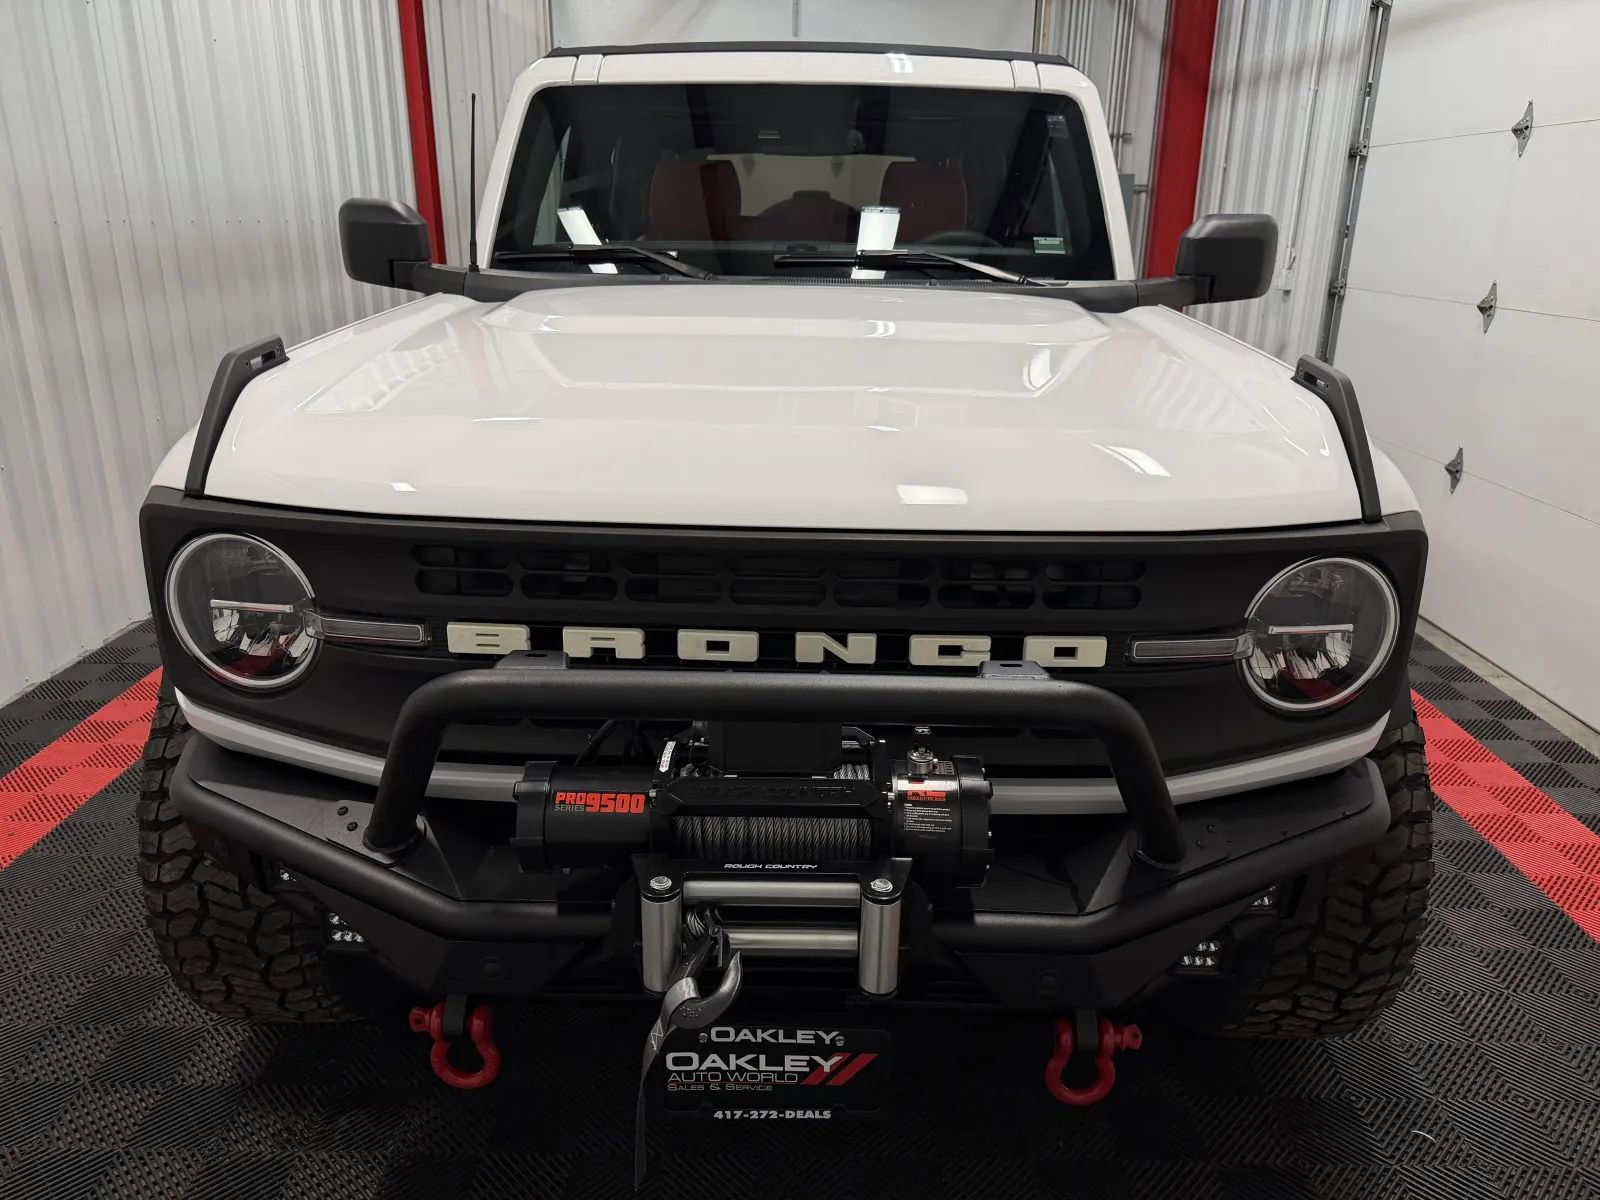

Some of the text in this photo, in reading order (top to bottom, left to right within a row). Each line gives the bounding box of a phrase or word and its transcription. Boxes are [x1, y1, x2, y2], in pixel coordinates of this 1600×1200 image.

[447, 621, 1107, 668] BRONCO
[555, 792, 586, 804] PRO
[585, 792, 645, 813] 9500
[554, 804, 585, 812] SERIES
[711, 1026, 840, 1045] OAKLEY
[666, 1052, 842, 1072] OAKLEY
[668, 1072, 798, 1083] AUTO WORLD
[667, 1083, 773, 1092] SALES & SERVICE
[714, 1110, 831, 1119] 417-272-DEALS
